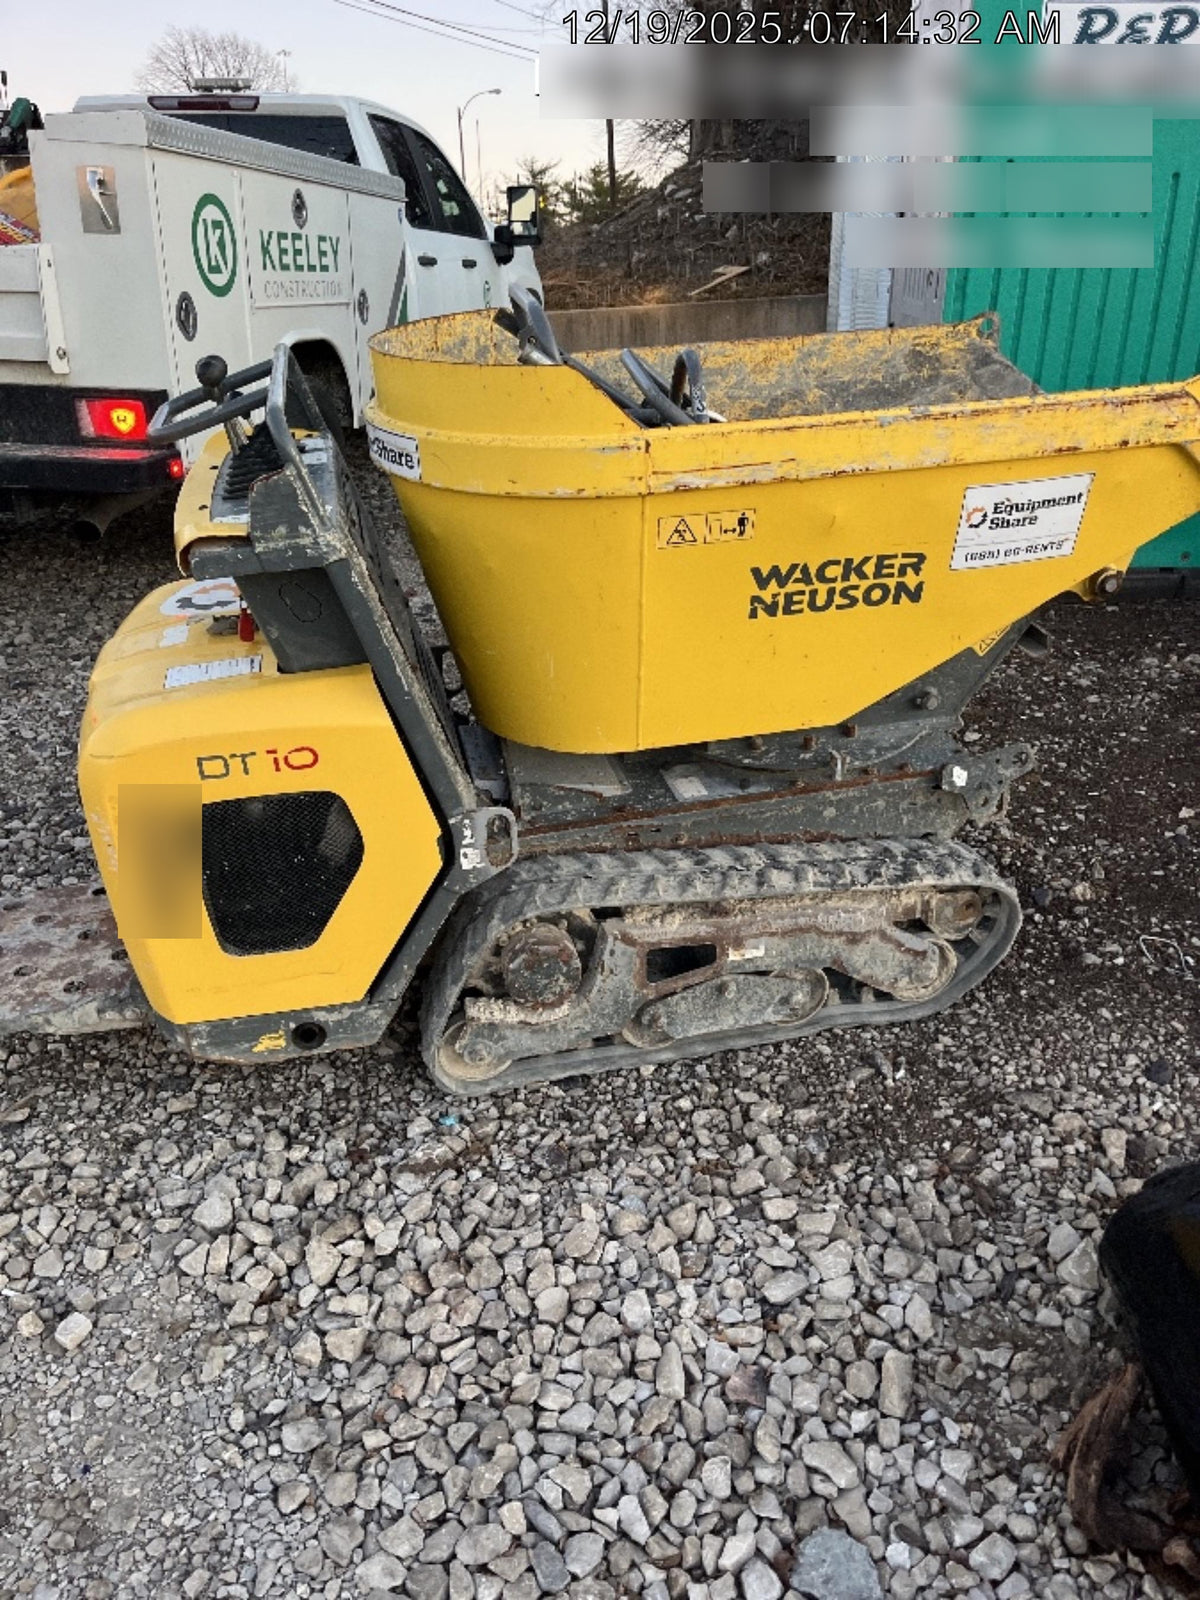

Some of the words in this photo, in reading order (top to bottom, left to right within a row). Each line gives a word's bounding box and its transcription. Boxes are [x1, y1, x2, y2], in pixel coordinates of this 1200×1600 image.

[259, 229, 340, 273] KEELEY
[264, 280, 343, 298] CONSTRUCTION
[992, 491, 1083, 516] Equipment
[988, 515, 1039, 530] Share
[750, 552, 927, 591] WACKER
[748, 581, 925, 620] NEUSON
